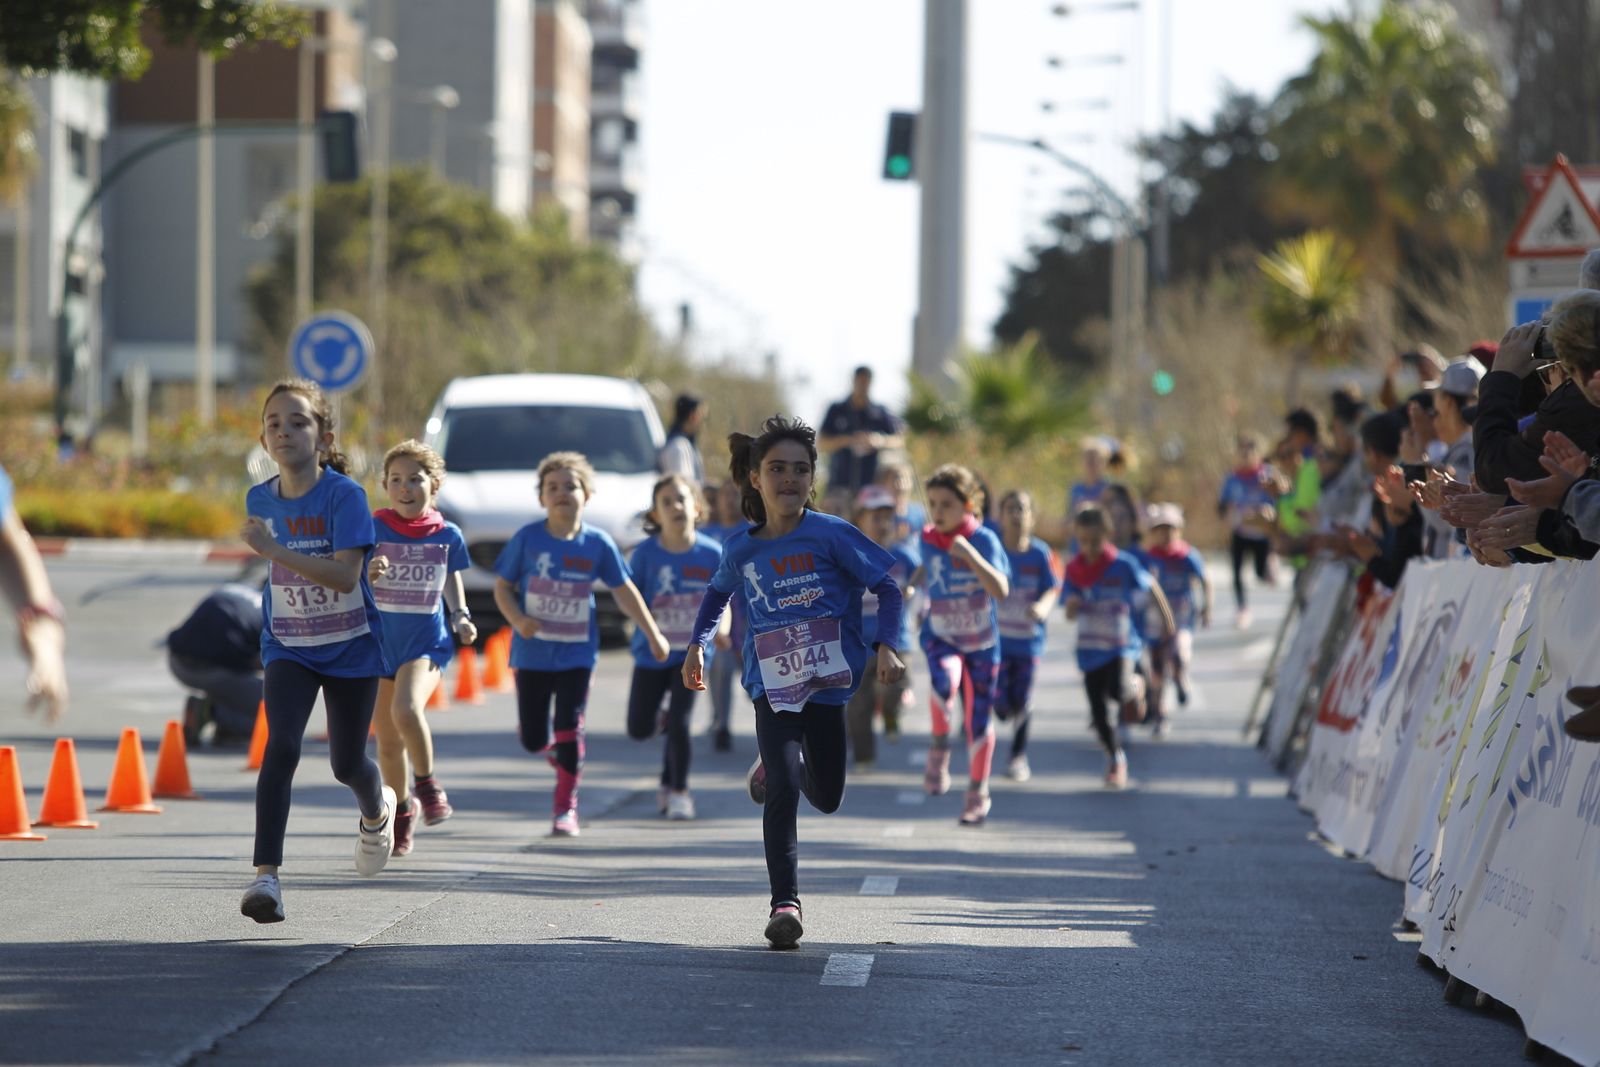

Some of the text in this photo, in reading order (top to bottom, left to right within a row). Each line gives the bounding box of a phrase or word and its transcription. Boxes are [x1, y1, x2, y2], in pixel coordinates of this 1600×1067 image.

[285, 515, 325, 537] VIII
[287, 539, 330, 549] CARRERA
[770, 551, 815, 576] VIII
[386, 565, 436, 581] 3208
[773, 572, 820, 588] CARRERA
[777, 586, 824, 609] mujer
[536, 598, 579, 614] 3071
[794, 623, 809, 632] VIII
[775, 645, 830, 677] 3044
